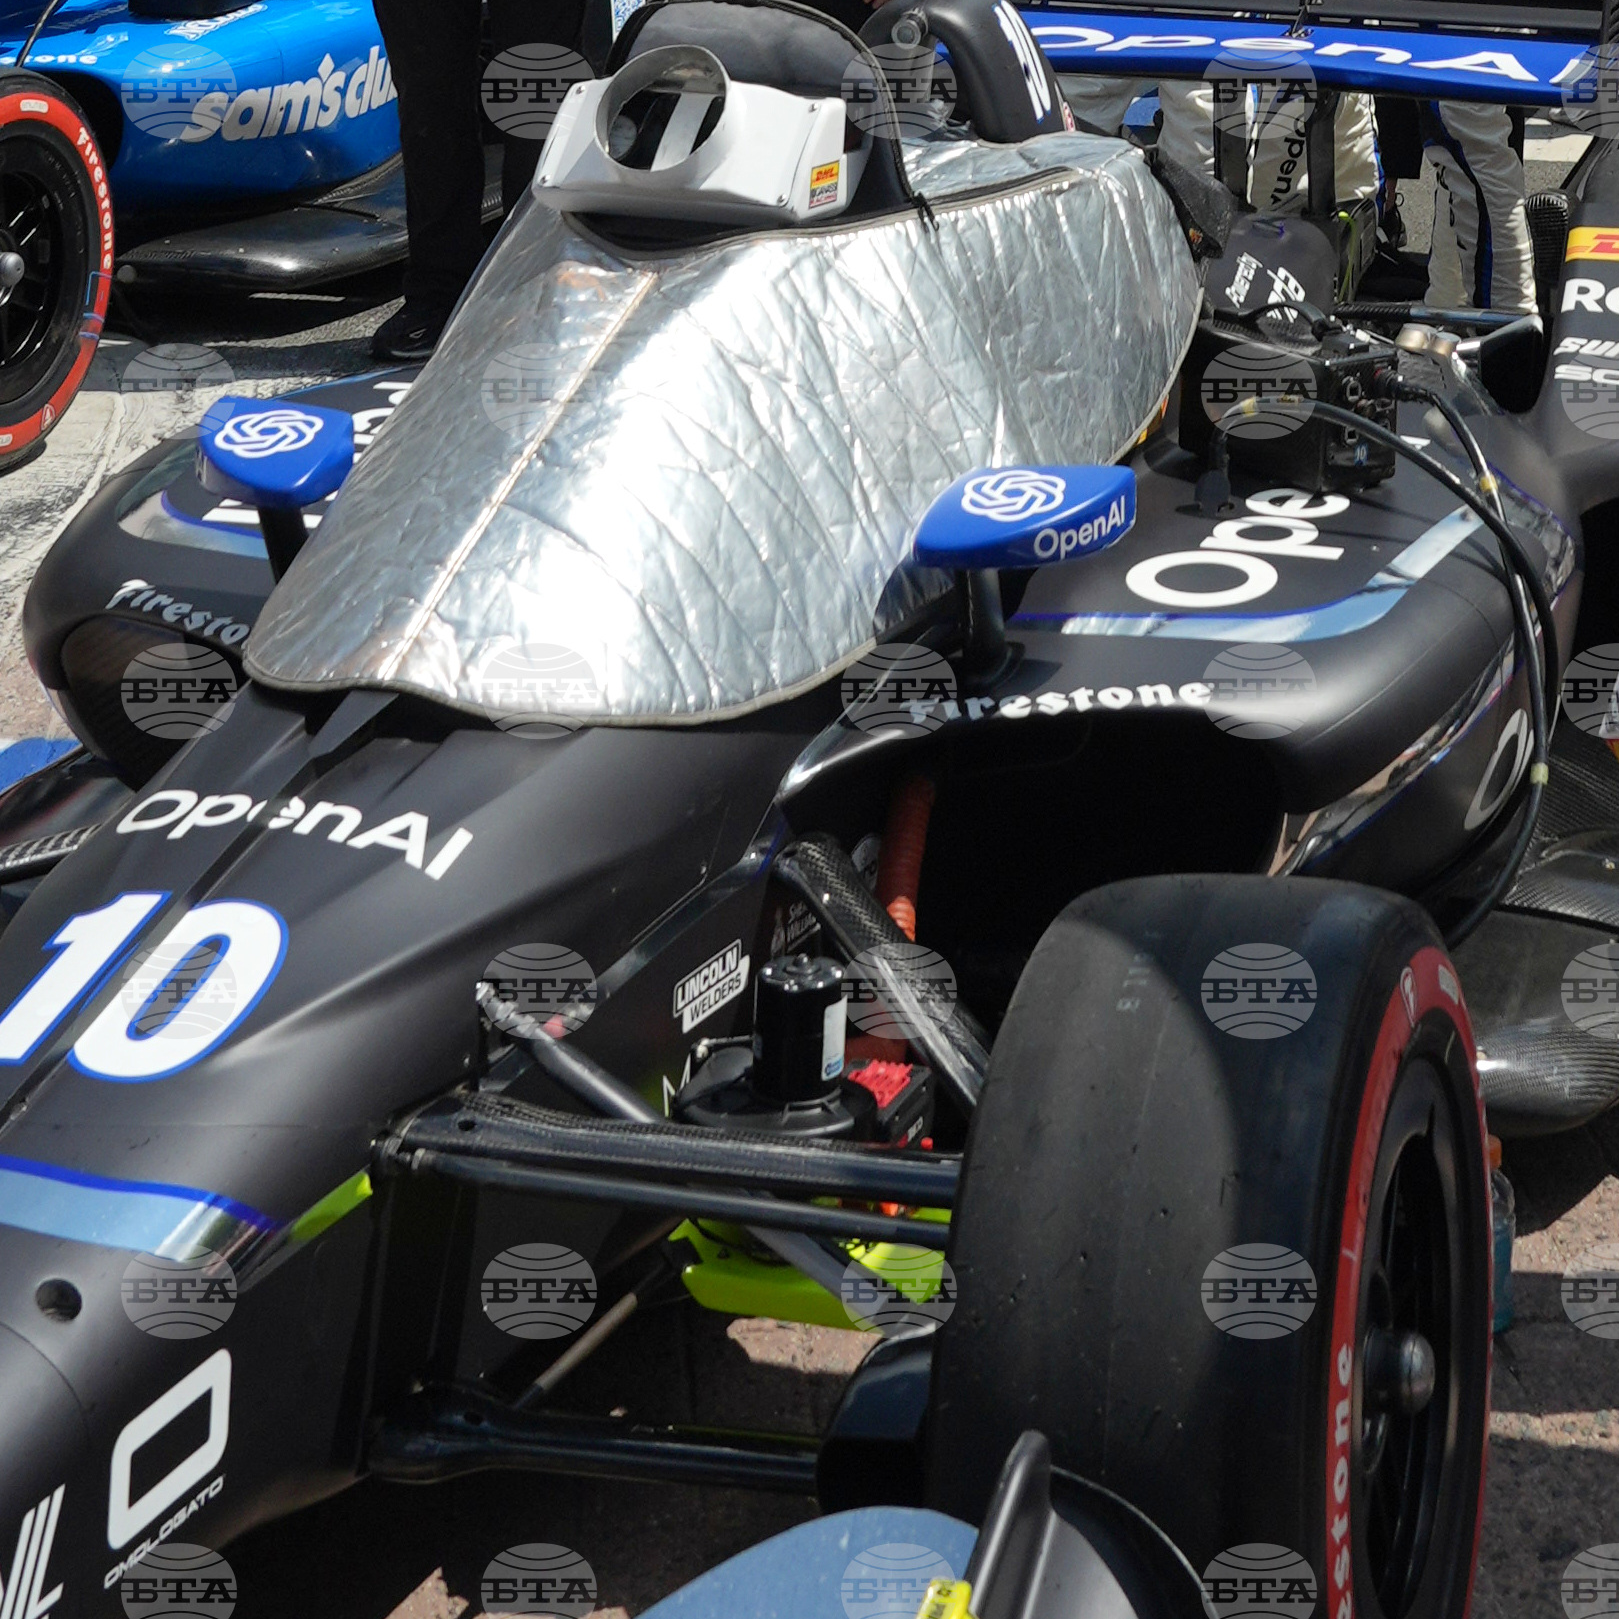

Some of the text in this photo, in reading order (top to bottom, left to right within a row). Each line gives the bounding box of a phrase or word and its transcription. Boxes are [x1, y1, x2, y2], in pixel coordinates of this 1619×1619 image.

[1030, 25, 1598, 86] OpenAI
[180, 53, 340, 143] sam's
[75, 124, 113, 270] Firestone
[1033, 494, 1126, 561] OpenAI
[900, 681, 1216, 726] Firestone
[115, 788, 474, 881] OpenAI
[0, 890, 290, 1084] 10
[676, 946, 739, 1008] LINCOLN
[690, 976, 742, 1023] WELDERS
[103, 1474, 225, 1590] OMOLOGATO
